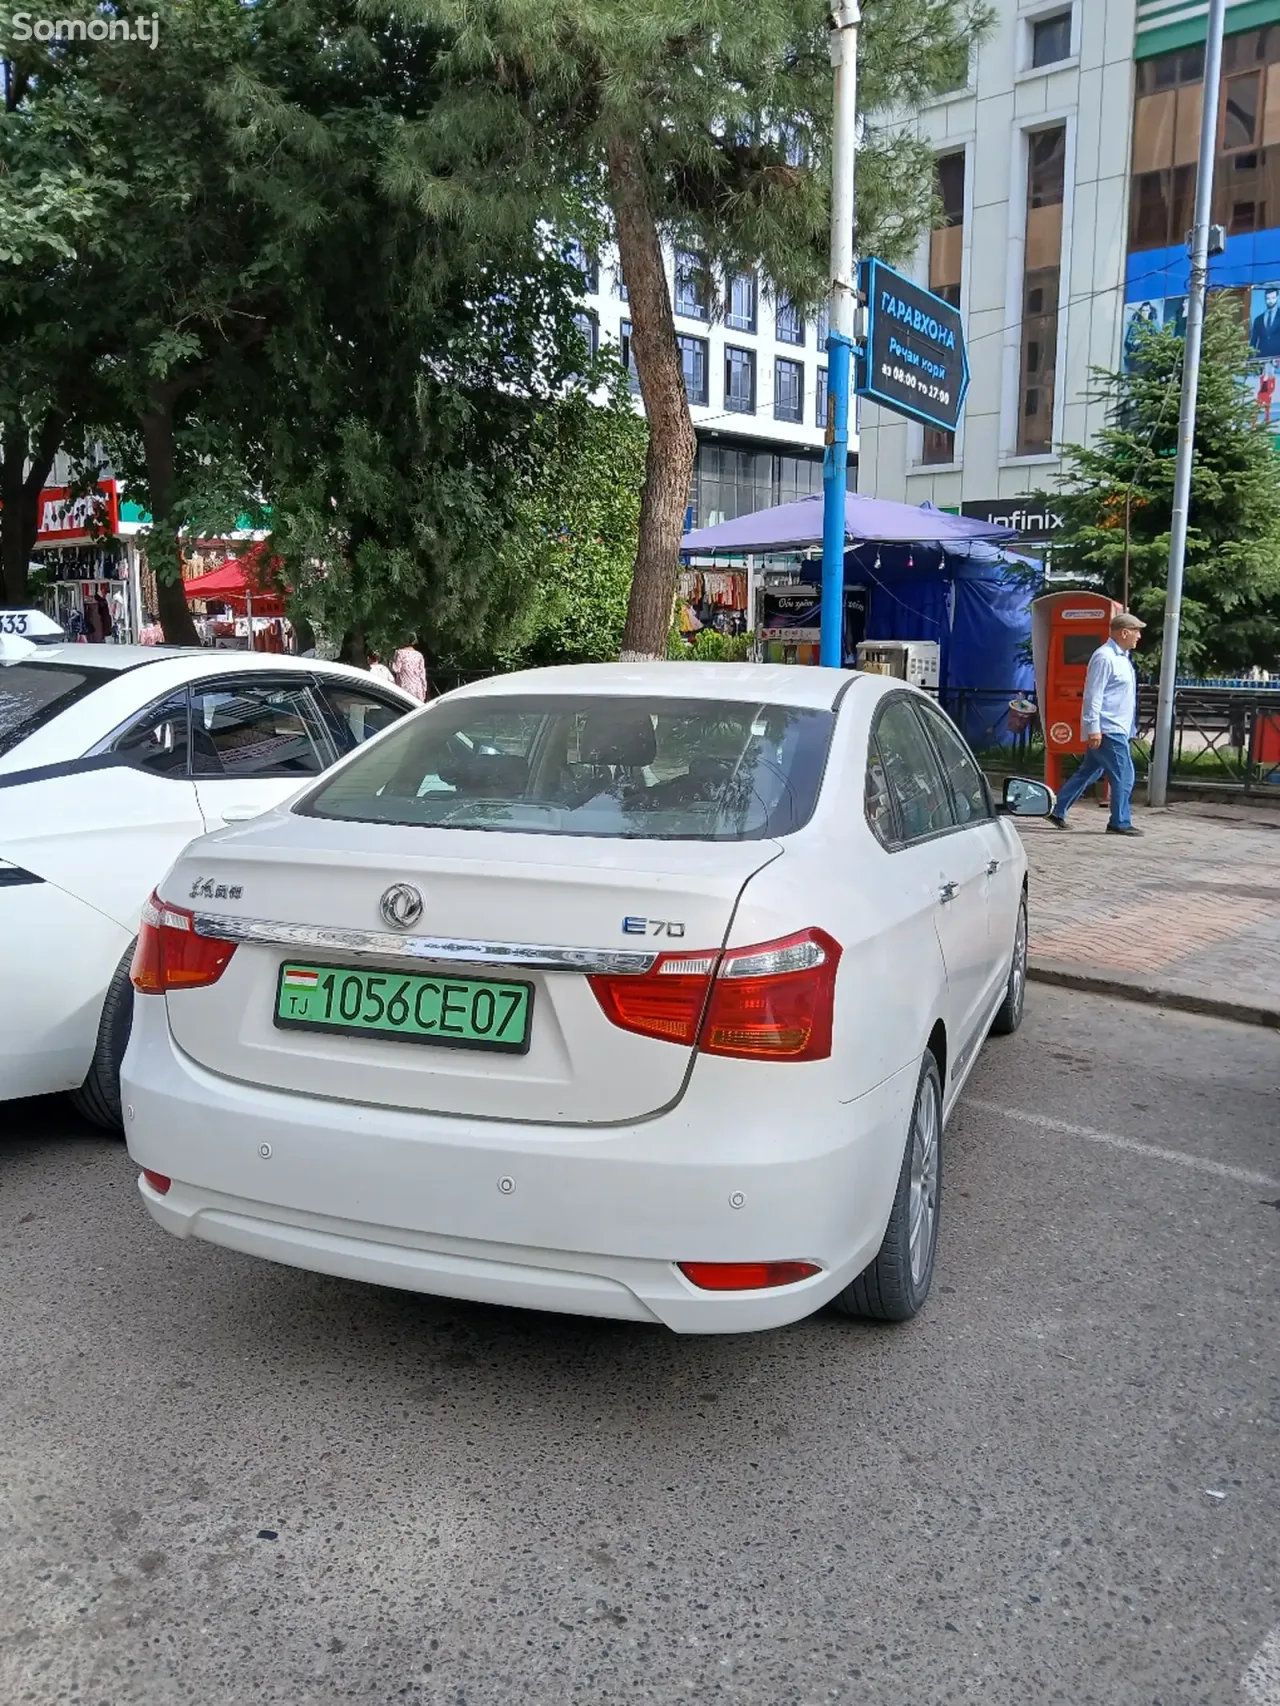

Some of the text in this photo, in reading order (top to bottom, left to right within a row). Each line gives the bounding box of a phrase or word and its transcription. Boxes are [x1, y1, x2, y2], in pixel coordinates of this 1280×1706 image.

[918, 382, 928, 394] то
[988, 509, 1065, 533] Infinix
[622, 916, 685, 938] E70
[289, 997, 309, 1015] TJ
[321, 974, 523, 1038] 1056CE07
